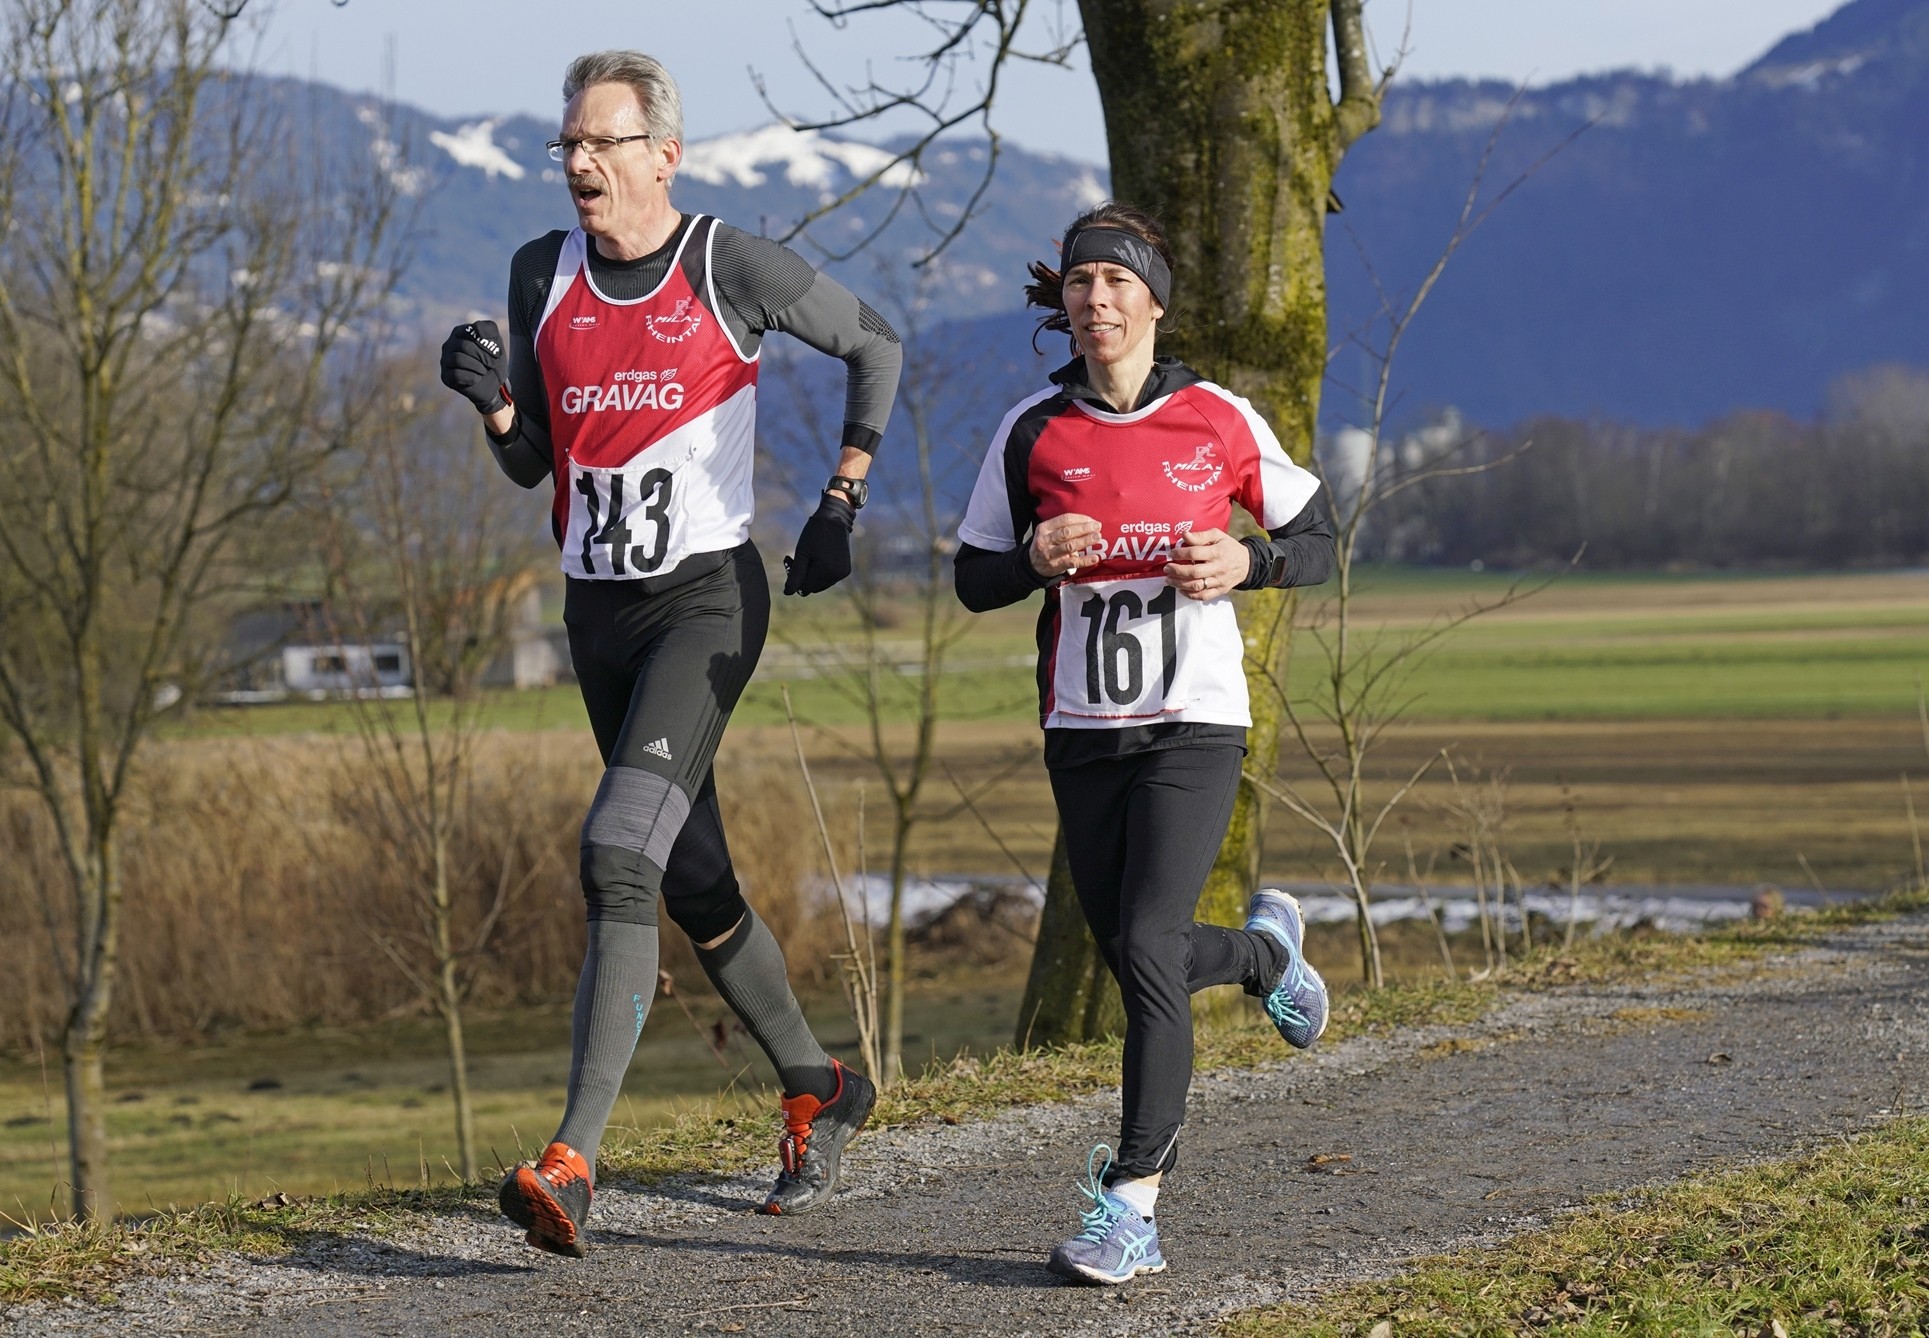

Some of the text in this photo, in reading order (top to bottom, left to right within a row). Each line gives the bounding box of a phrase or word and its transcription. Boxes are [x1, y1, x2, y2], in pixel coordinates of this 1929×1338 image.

[645, 313, 702, 344] RHEINTAL
[654, 315, 693, 323] MILA
[465, 325, 500, 355] Snfit
[614, 368, 658, 383] erdgas
[561, 382, 685, 414] GRAVAG
[1161, 461, 1224, 492] RHEINTAL
[1173, 462, 1214, 471] MILA
[575, 467, 673, 575] 143
[1120, 520, 1171, 535] erdgas
[1079, 535, 1187, 561] RAVA
[1080, 585, 1177, 705] 161
[642, 745, 673, 761] adidas
